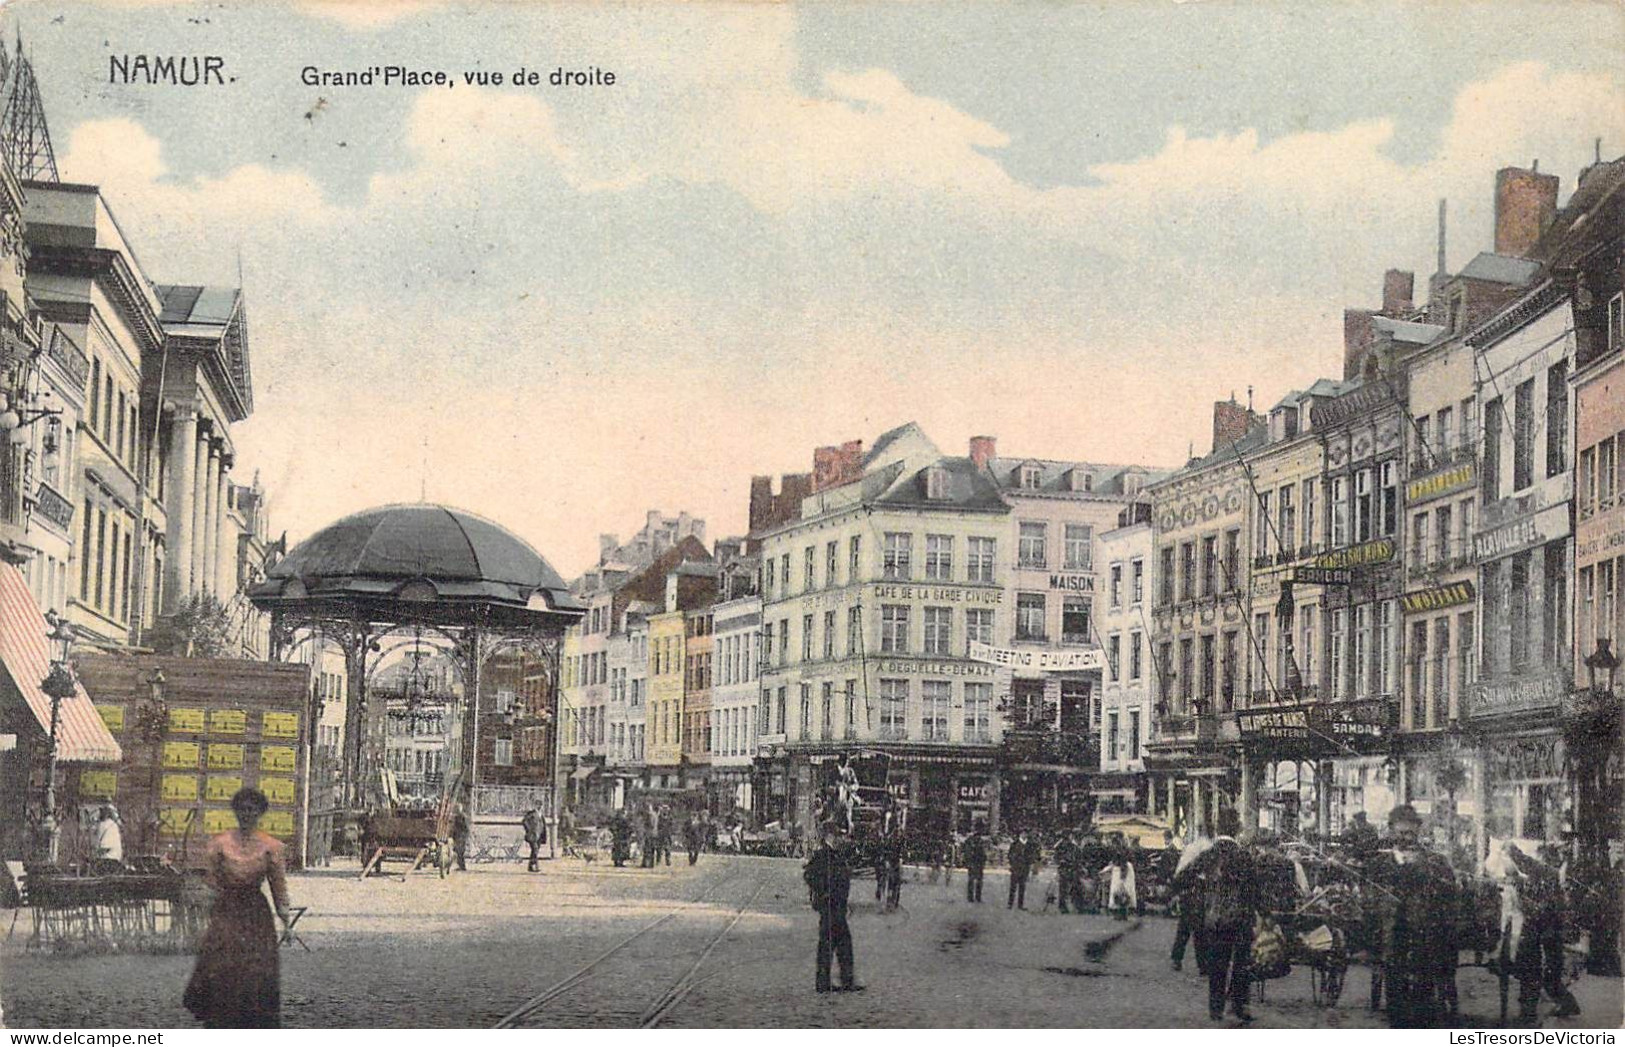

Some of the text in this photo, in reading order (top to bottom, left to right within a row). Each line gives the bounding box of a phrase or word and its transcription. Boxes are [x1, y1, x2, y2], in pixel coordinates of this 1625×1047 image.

[1049, 574, 1095, 591] MAISON
[901, 587, 912, 599] DE
[918, 588, 929, 600] LA
[933, 589, 961, 601] GARDE
[965, 591, 1002, 604] CIVIQUE
[987, 647, 1032, 666] MEETING
[1040, 650, 1098, 667] D'AVIATION
